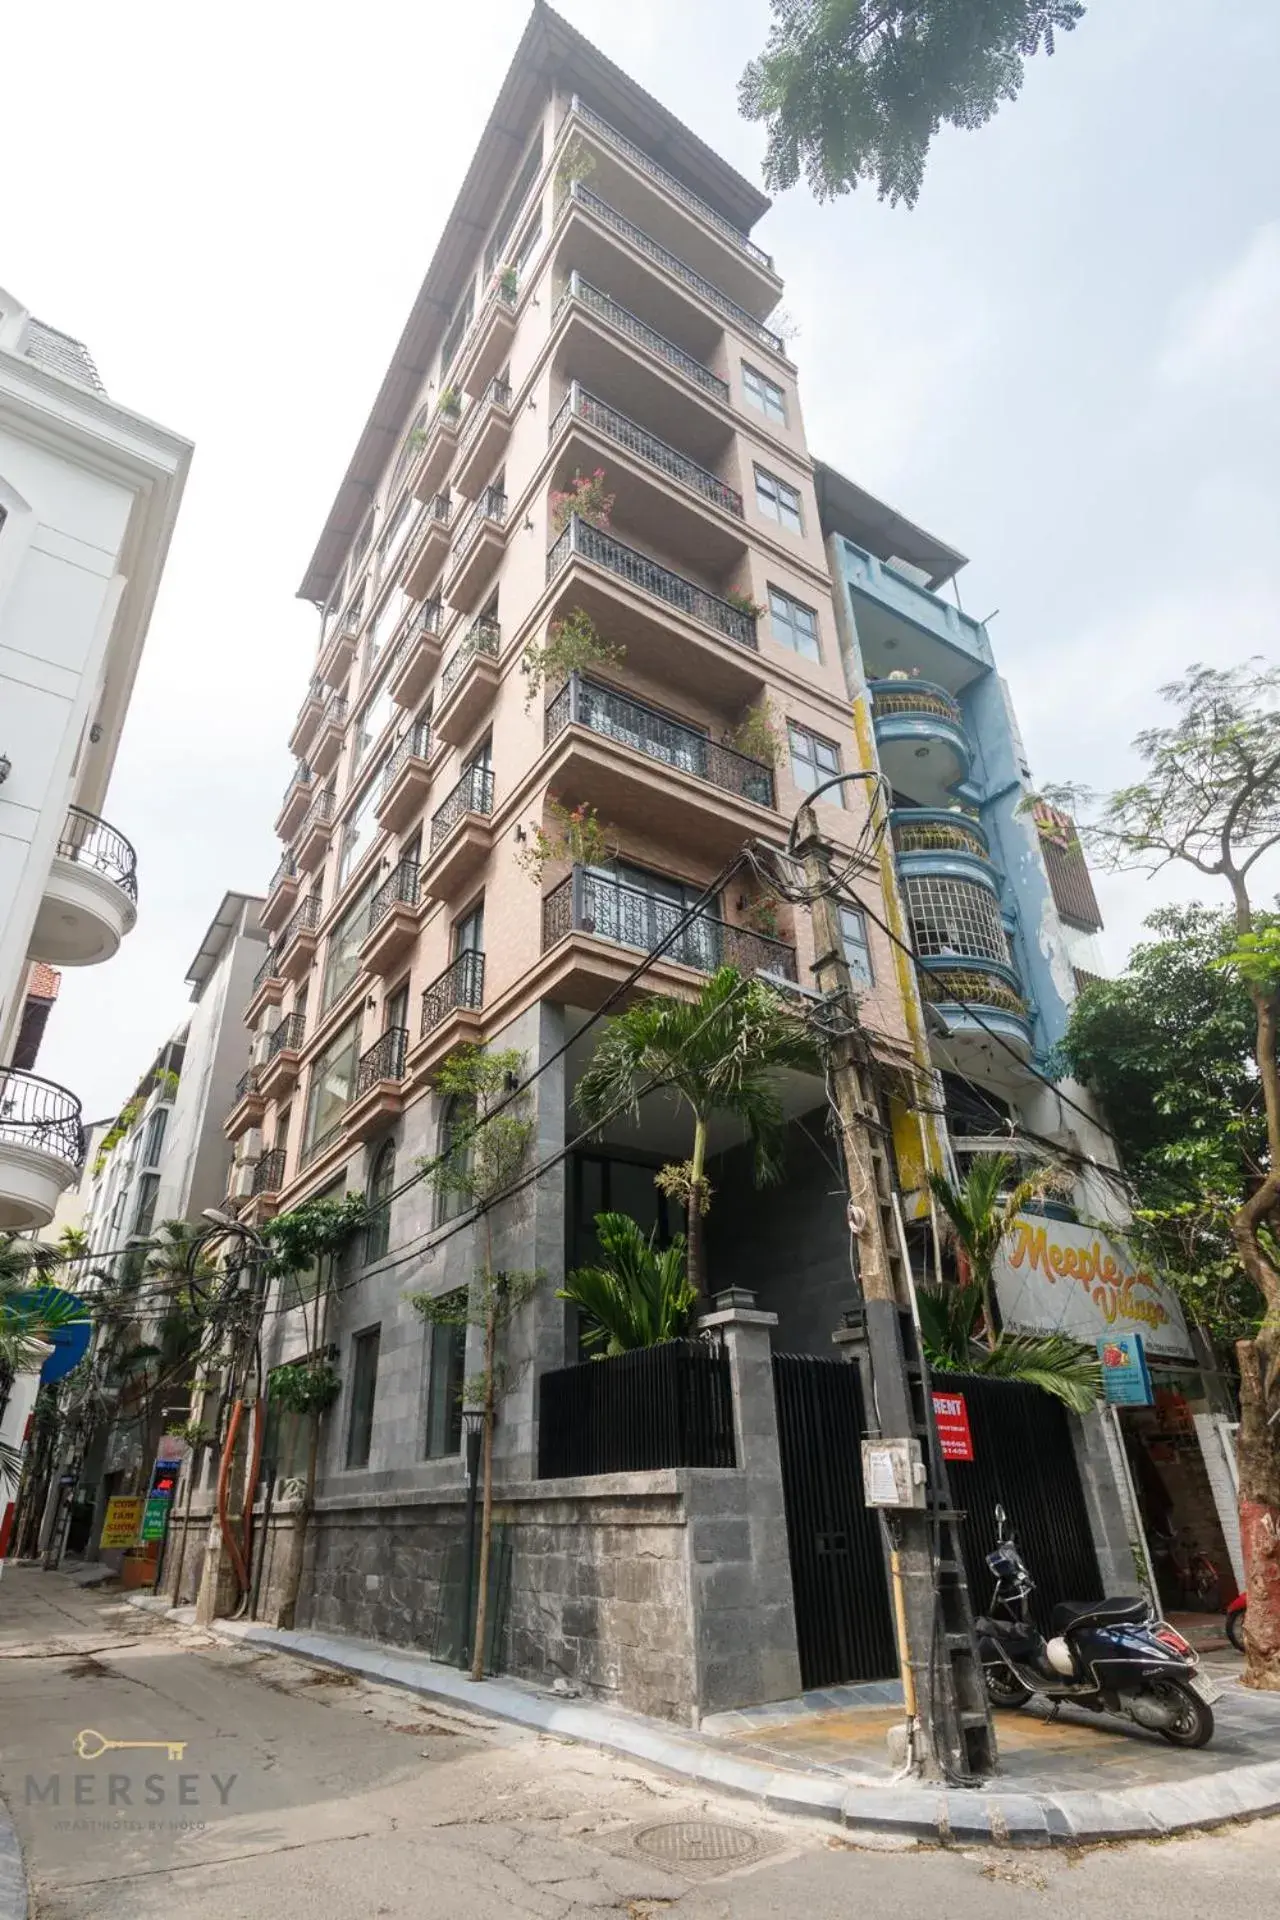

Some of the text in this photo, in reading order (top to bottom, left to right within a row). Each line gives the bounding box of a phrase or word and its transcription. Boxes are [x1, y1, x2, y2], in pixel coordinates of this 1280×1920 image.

[1009, 1219, 1124, 1292] Meeple
[1092, 1273, 1169, 1330] Village
[932, 1398, 961, 1416] RENT
